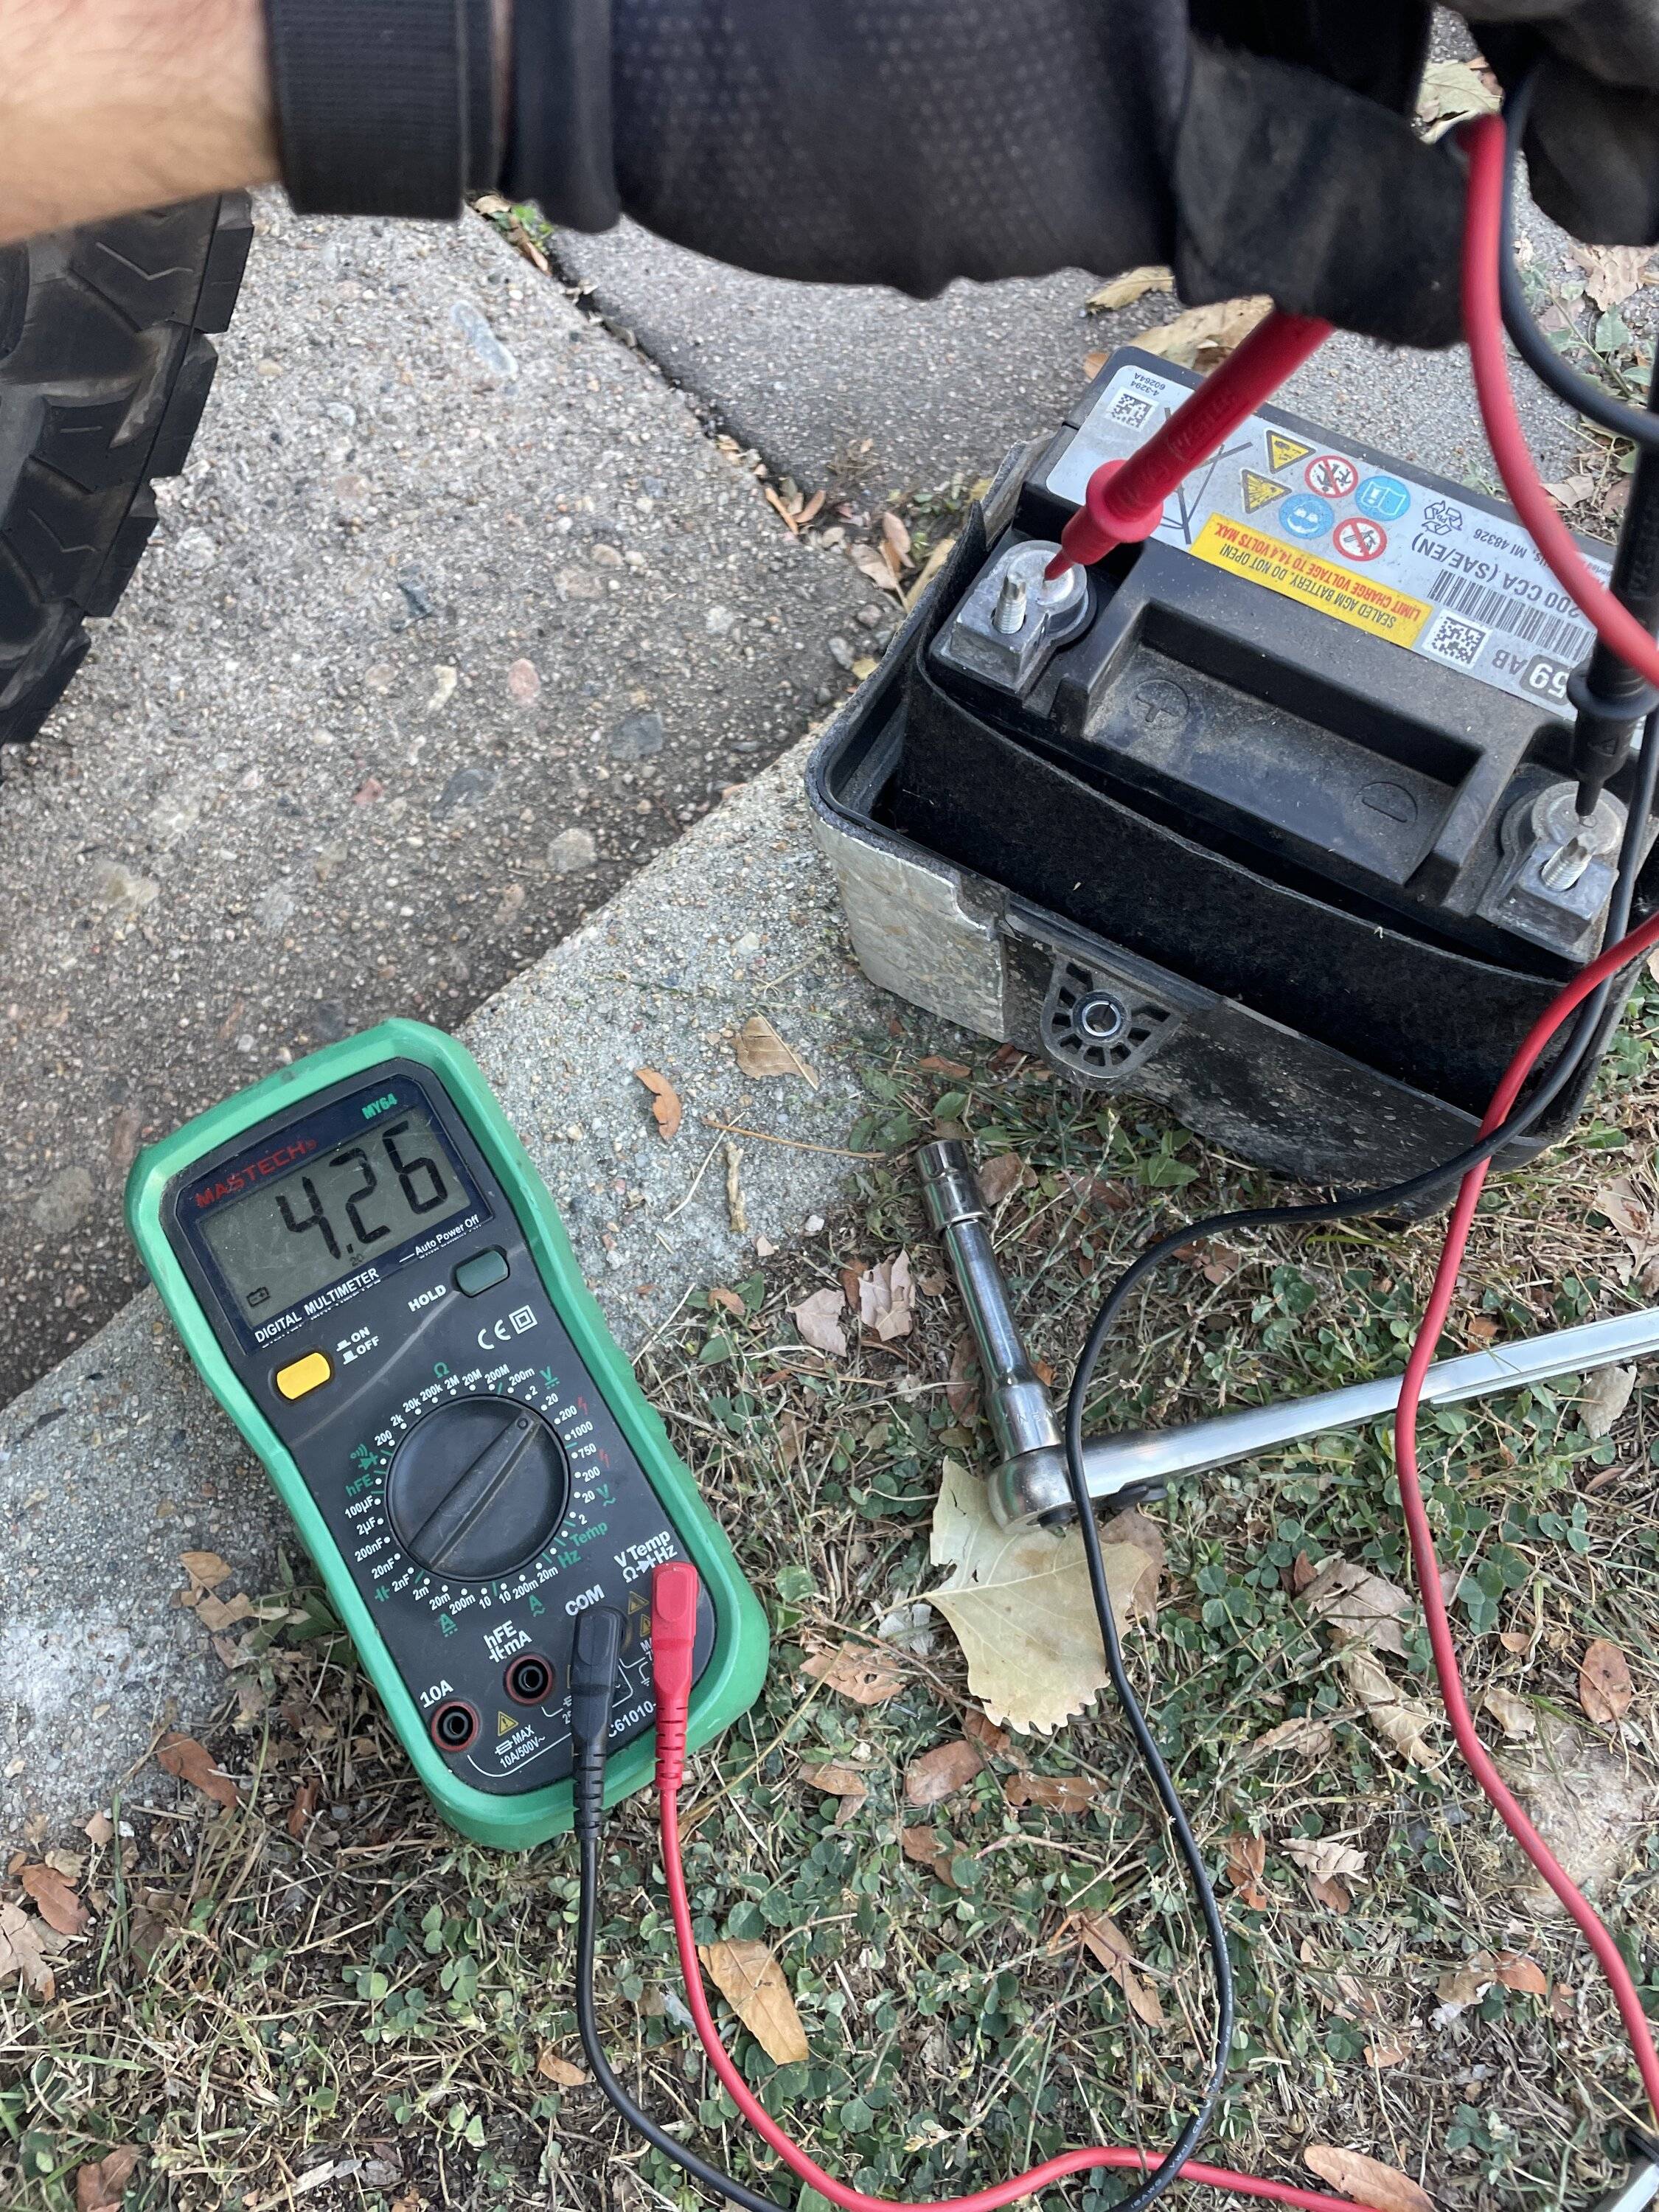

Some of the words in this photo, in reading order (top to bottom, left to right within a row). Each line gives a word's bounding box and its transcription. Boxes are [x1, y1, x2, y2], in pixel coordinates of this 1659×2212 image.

[1130, 380, 1159, 396] 4-3294
[1214, 523, 1240, 543] MAX.
[1473, 529, 1510, 549] 48326
[1220, 543, 1251, 565] OPEN!
[1238, 534, 1270, 556] VOLTS
[1510, 544, 1527, 559] MI
[1249, 557, 1272, 574] NOT
[1270, 547, 1292, 565] 14.4
[1293, 558, 1307, 572] TO
[1411, 532, 1498, 581] (SAE/EN)
[1271, 566, 1288, 581] DO
[1307, 563, 1351, 592] VOLTAGE
[1351, 582, 1392, 608] CHARGE
[1503, 573, 1543, 601] CCA
[1334, 592, 1360, 612] AGM
[1391, 601, 1422, 622] LIMIT
[1357, 604, 1397, 629] SEALED
[1492, 650, 1528, 675] AB
[361, 1093, 397, 1119] MY64
[275, 1121, 448, 1260] 4.26
[414, 1239, 437, 1256] Auto
[435, 1224, 465, 1244] Power
[464, 1214, 480, 1228] Off
[254, 1311, 302, 1343] DIGITAL
[304, 1268, 380, 1316] MULTIMETER
[408, 1284, 446, 1312] HOLD
[350, 1326, 370, 1343] ON
[355, 1336, 380, 1355] OFF
[444, 1374, 460, 1390] 2M
[462, 1368, 483, 1386] 20M
[484, 1364, 510, 1384] 200M
[509, 1368, 535, 1386] 200m
[420, 1384, 443, 1402] 200k
[529, 1385, 538, 1396] 2
[546, 1393, 559, 1406] 20
[403, 1398, 422, 1413] 20k
[559, 1405, 577, 1421] 200
[390, 1414, 404, 1427] 2k
[571, 1421, 594, 1439] 1000
[375, 1430, 392, 1446] 200
[578, 1443, 597, 1458] 750
[582, 1466, 601, 1482] 200
[346, 1474, 374, 1497] hFE
[582, 1490, 595, 1503] 20
[578, 1514, 588, 1525] 2
[569, 1522, 608, 1546] Temp
[355, 1537, 383, 1562] 200nF
[613, 1551, 627, 1568] V
[627, 1531, 670, 1560] Temp
[654, 1545, 678, 1564] Hz
[372, 1558, 394, 1579] 20nF
[557, 1550, 582, 1569] Hz
[392, 1573, 411, 1592] 2nF
[537, 1566, 559, 1583] 20m
[413, 1586, 429, 1600] 2m
[499, 1591, 512, 1604] 10
[512, 1579, 539, 1599] 200m
[429, 1593, 451, 1610] 20m
[449, 1595, 476, 1615] 200m
[479, 1596, 492, 1609] 10
[565, 1584, 605, 1615] COM
[483, 1620, 517, 1649] hFE
[504, 1630, 532, 1655] mA
[420, 1680, 453, 1708] 10A
[511, 1725, 535, 1745] MAX
